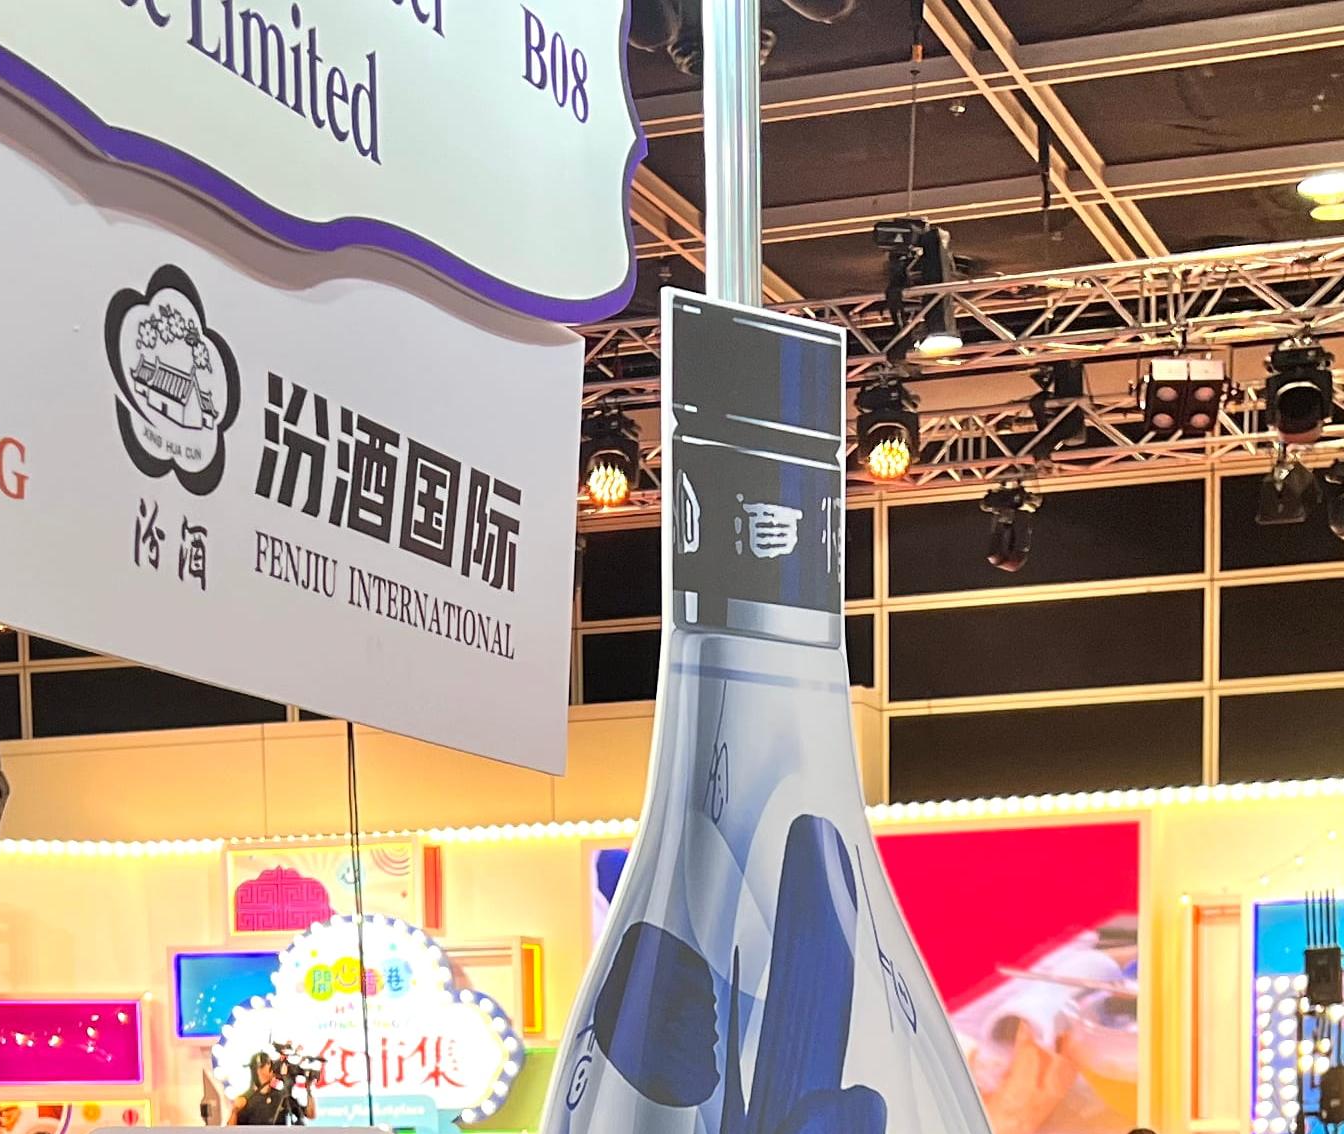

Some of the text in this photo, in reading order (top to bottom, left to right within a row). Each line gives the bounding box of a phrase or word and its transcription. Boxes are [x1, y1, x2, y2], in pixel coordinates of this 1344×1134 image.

[521, 4, 588, 124] B08
[166, 440, 182, 457] HUA
[255, 371, 522, 593] 汾酒国际
[255, 530, 516, 660] FENJIU INTERNATIONAL
